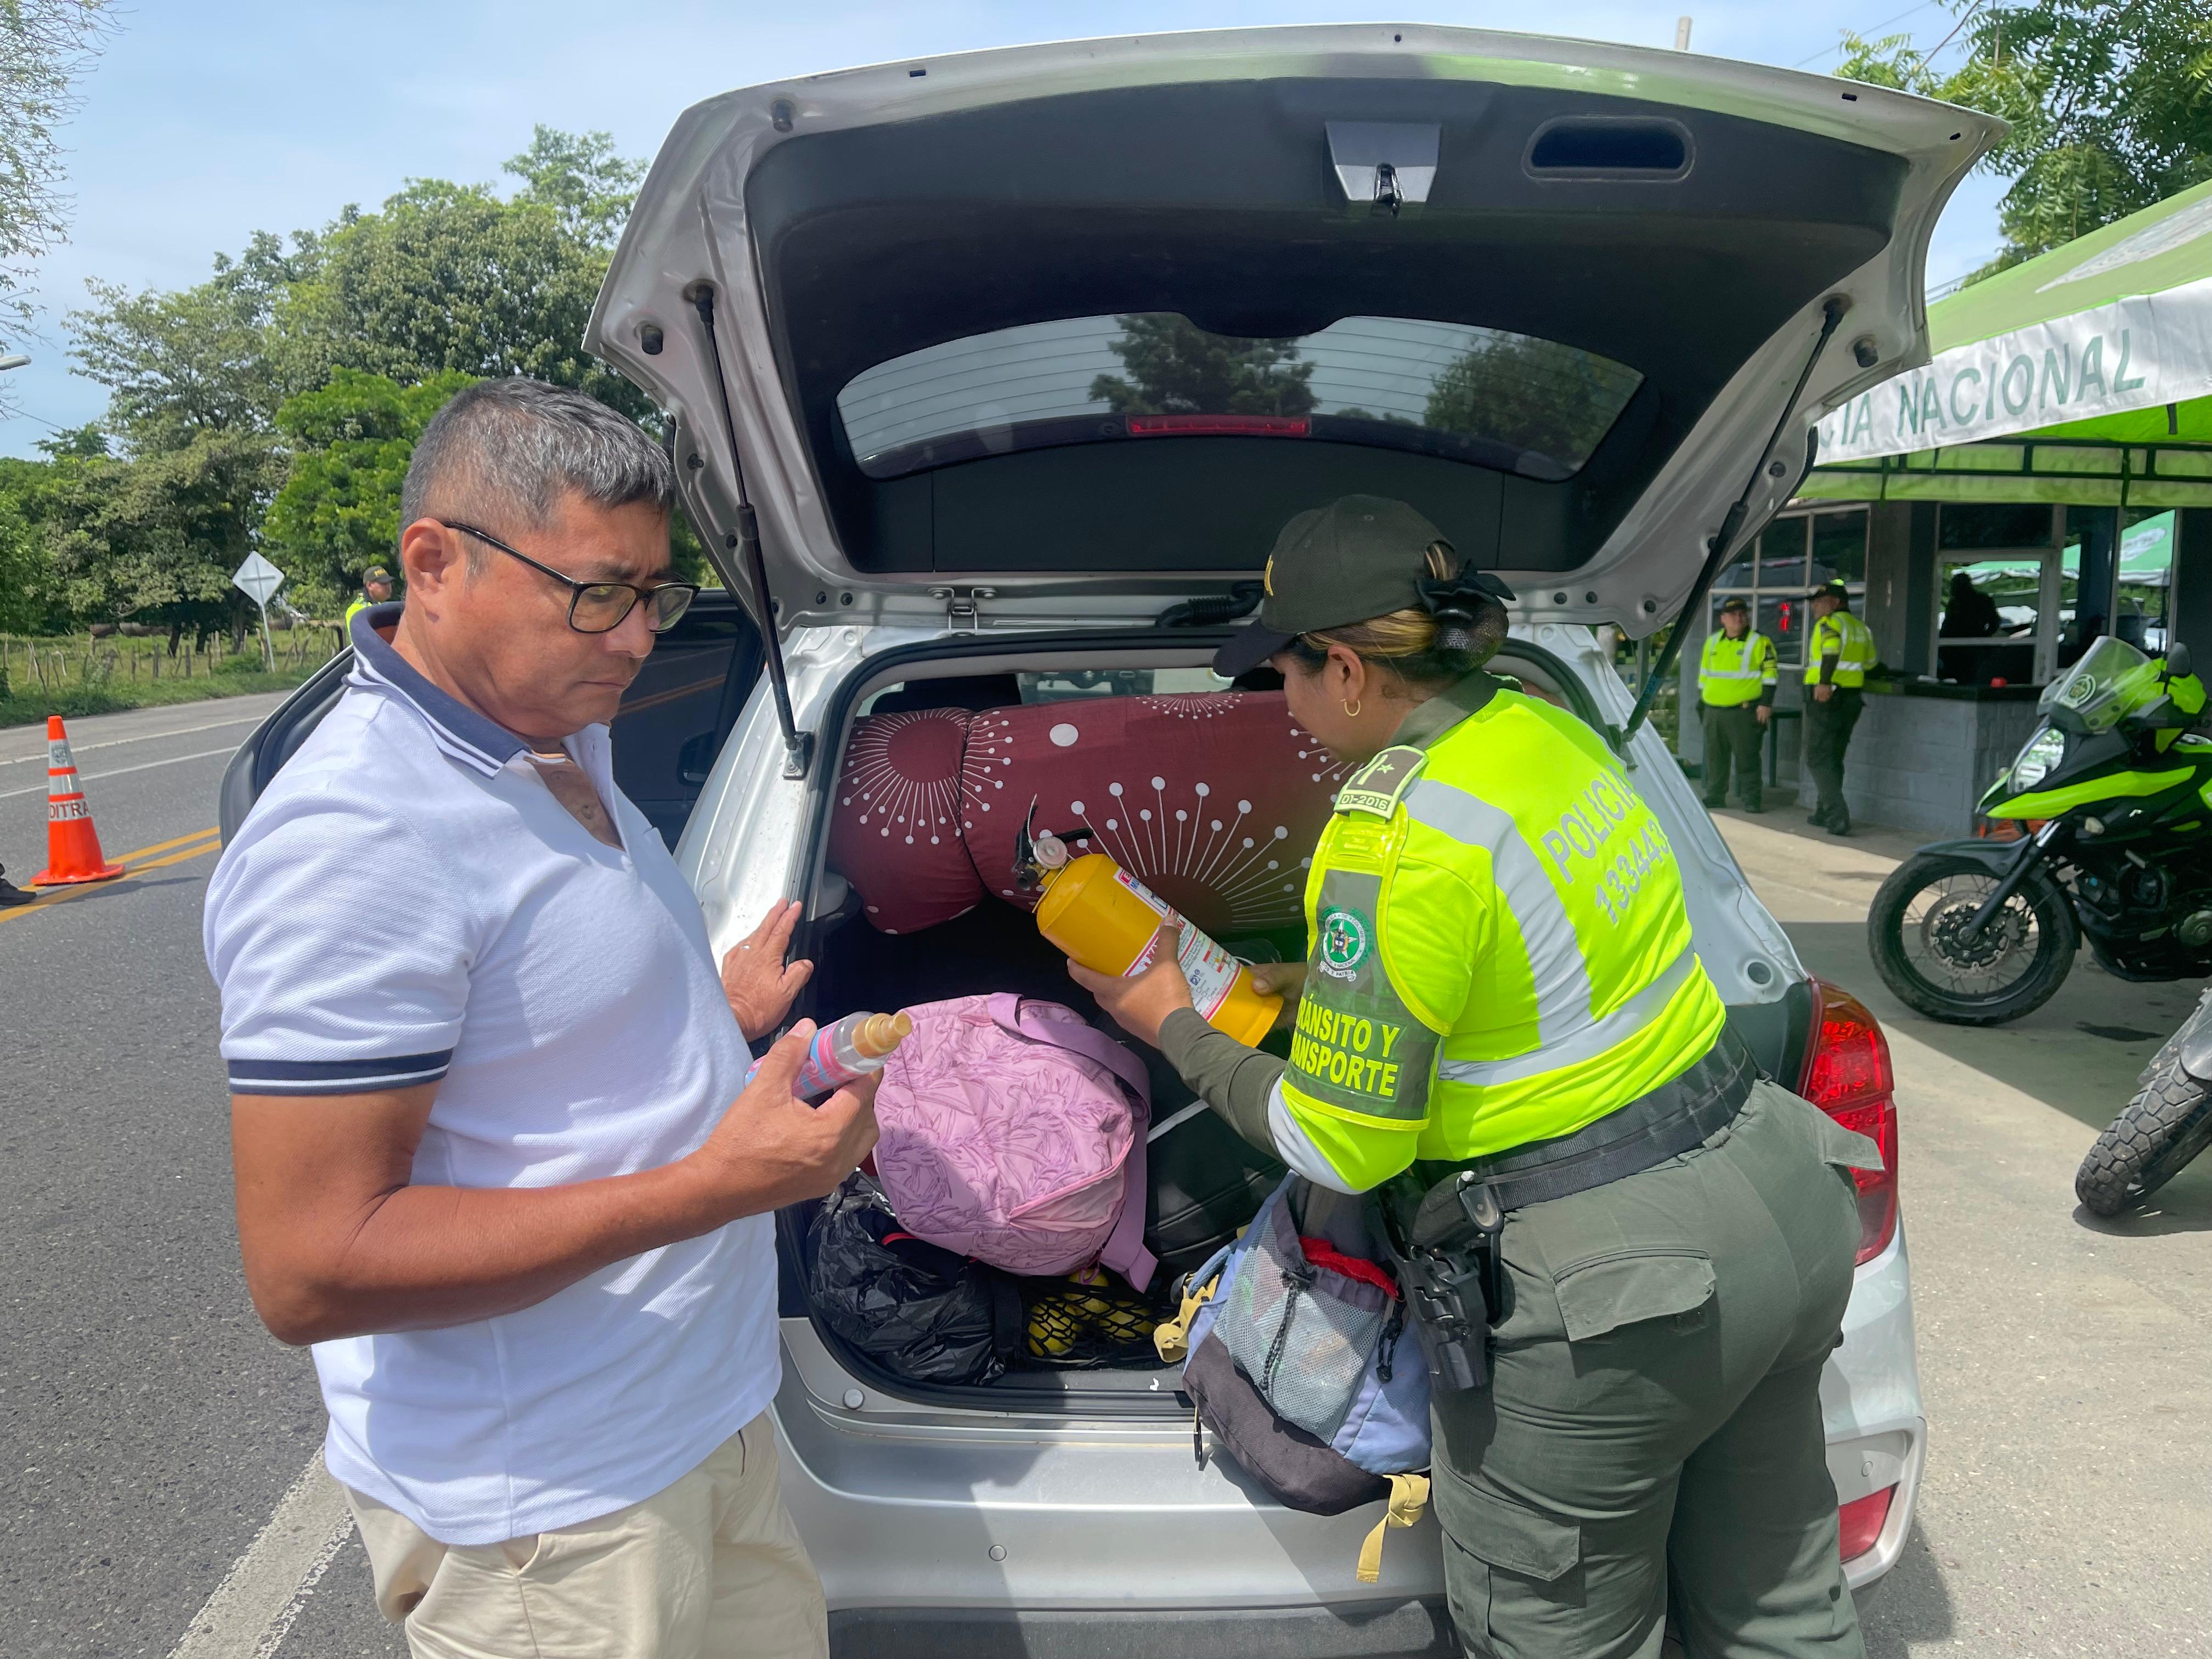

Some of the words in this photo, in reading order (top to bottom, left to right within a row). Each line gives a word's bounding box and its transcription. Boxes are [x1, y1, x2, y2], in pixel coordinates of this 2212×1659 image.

[1898, 328, 2146, 437] NACIONAL
[1341, 794, 1388, 810] 01-2016
[1541, 764, 1637, 884] POLICIA
[1595, 819, 1669, 924] 133443
[1291, 1031, 1398, 1097] RANSPORTE
[1296, 993, 1372, 1052] RÁNSITO
[1382, 1024, 1400, 1058] Y
